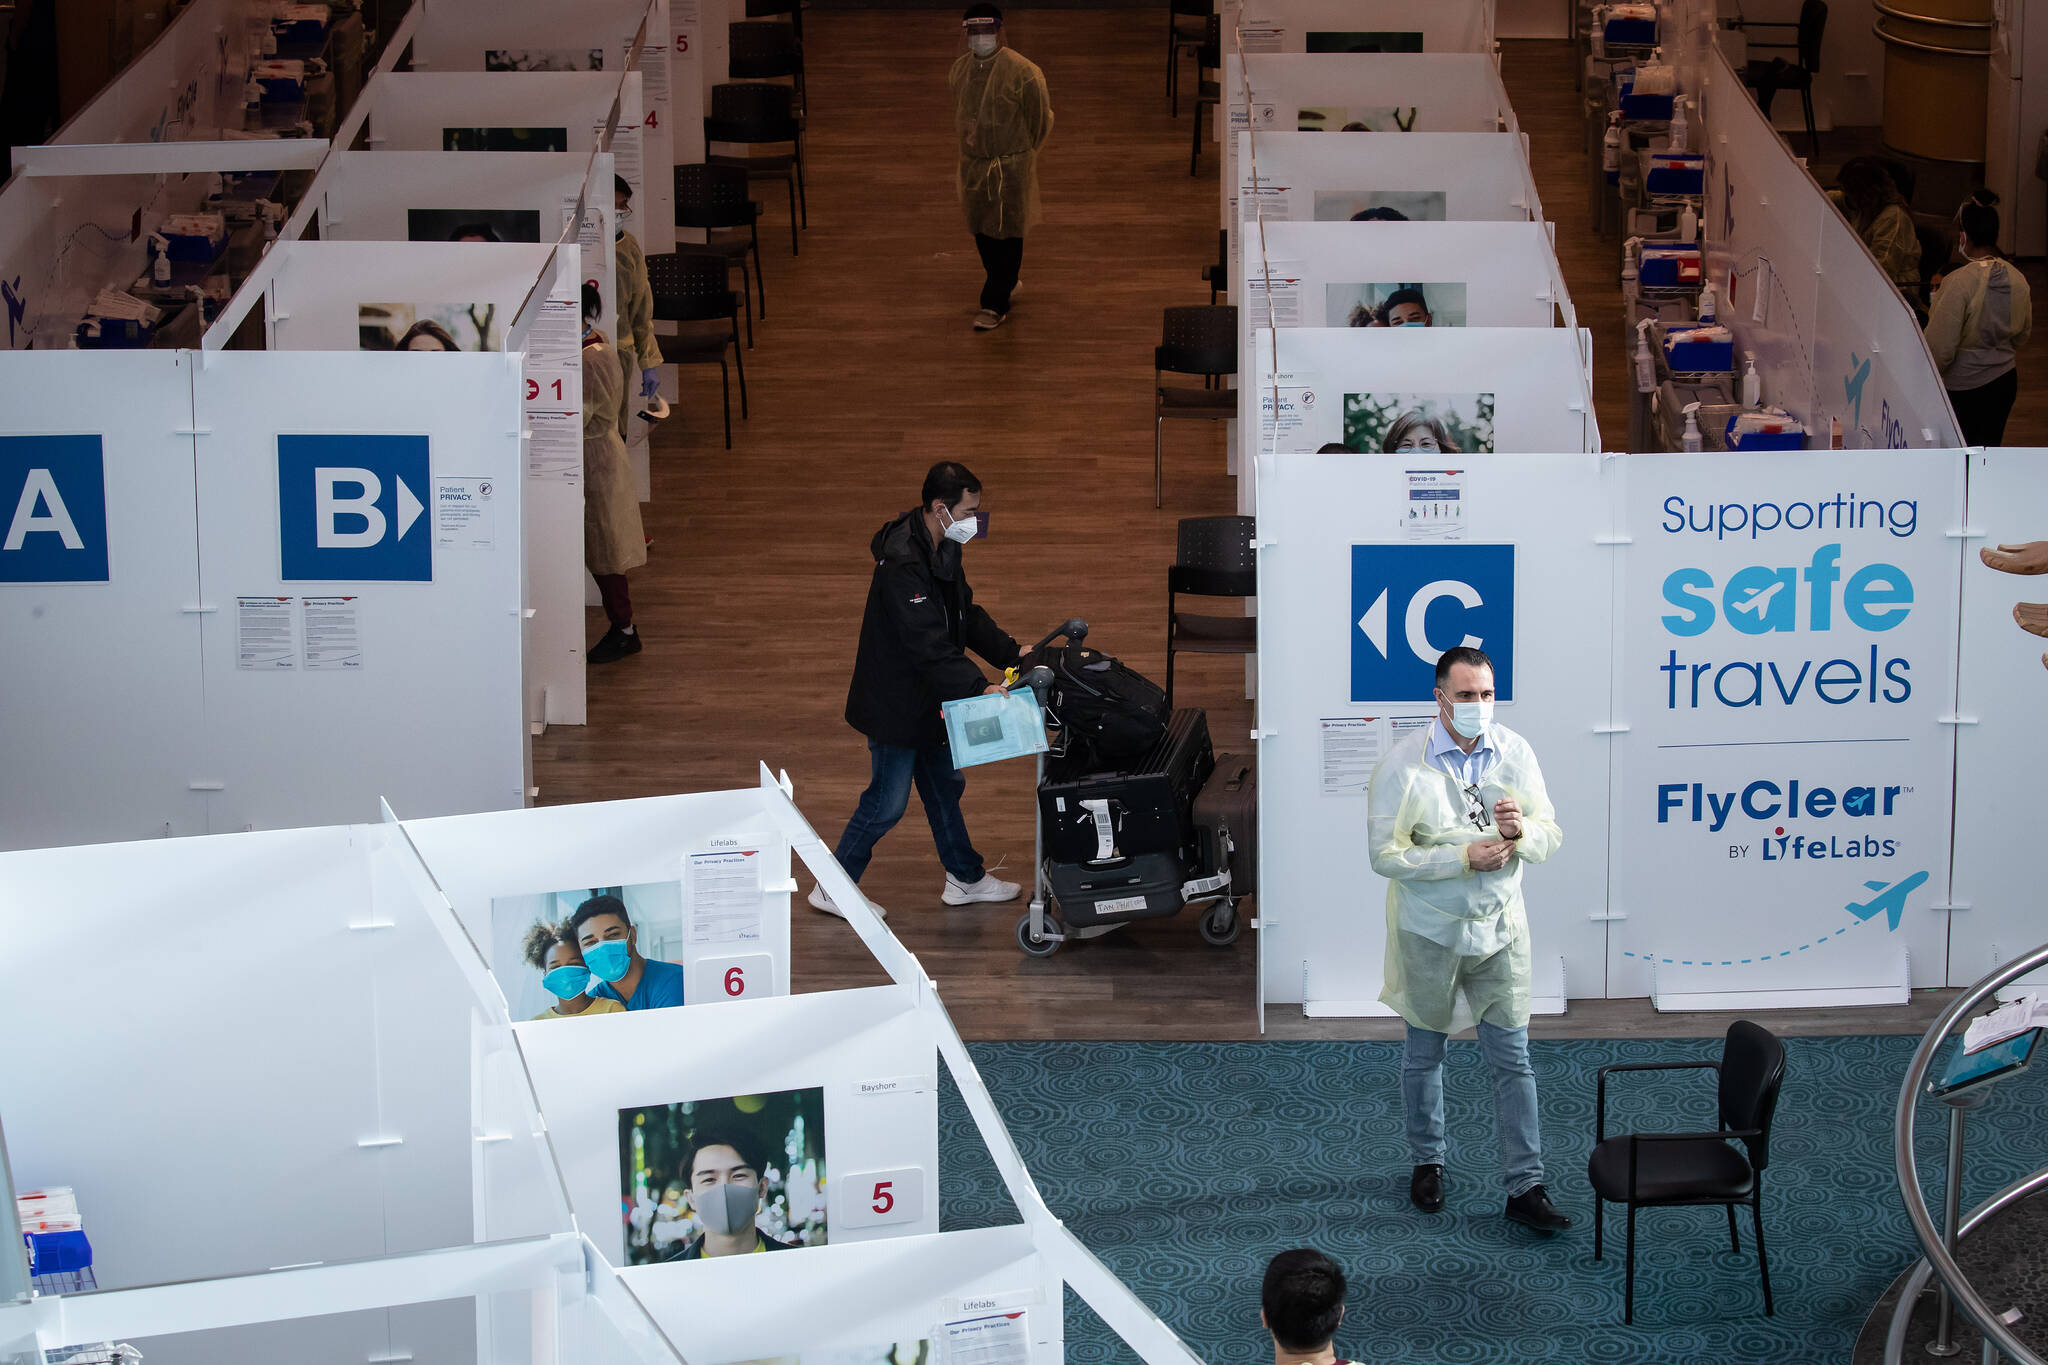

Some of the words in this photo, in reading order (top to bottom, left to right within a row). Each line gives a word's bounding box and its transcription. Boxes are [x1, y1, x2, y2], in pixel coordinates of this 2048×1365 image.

[676, 35, 688, 52] 5
[645, 110, 658, 129] 4
[552, 378, 562, 401] 1
[3, 468, 86, 550] A
[315, 467, 387, 548] B
[1662, 493, 1917, 540] Supporting
[1661, 543, 1914, 637] safe
[1405, 580, 1484, 667] C
[1660, 644, 1912, 709] travels
[711, 839, 738, 847] Lifelabs
[1729, 845, 1749, 858] BY
[724, 967, 745, 997] 6
[861, 1082, 897, 1092] Bayshore
[872, 1181, 894, 1214] 5
[963, 1300, 996, 1311] Lifelabs
